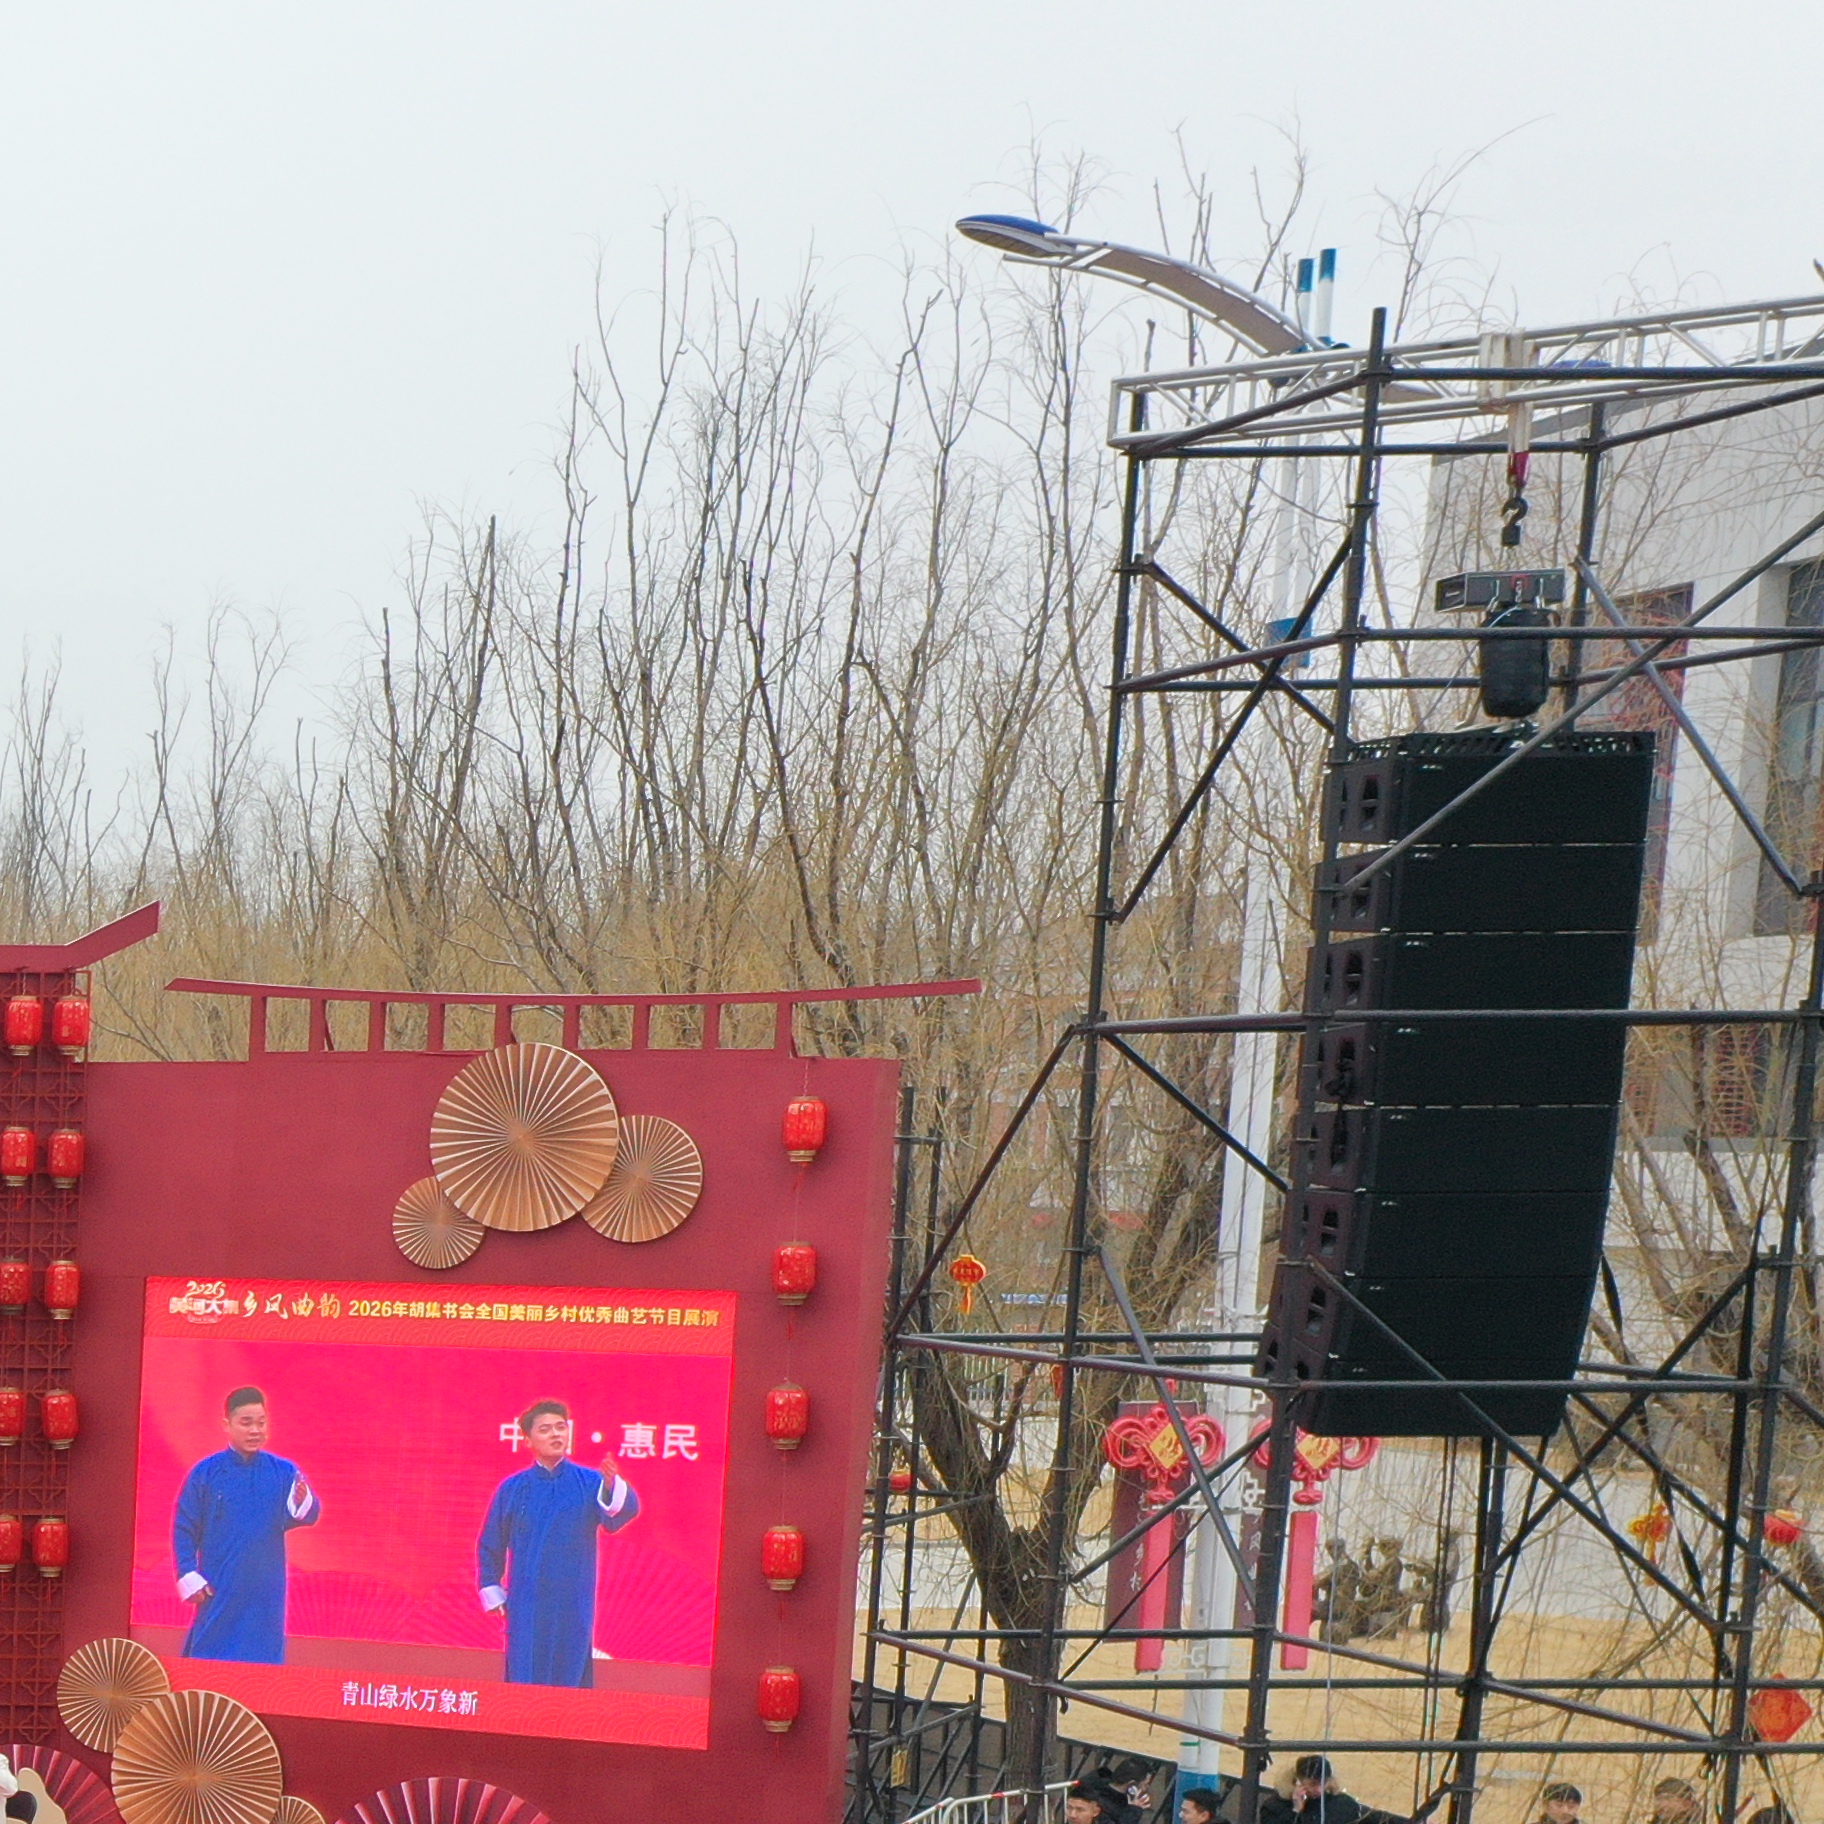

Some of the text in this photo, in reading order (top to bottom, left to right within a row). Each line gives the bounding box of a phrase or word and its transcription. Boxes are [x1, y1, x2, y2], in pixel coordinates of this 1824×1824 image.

[242, 1291, 720, 1328] 乡风曲韵 2026年胡集书会全国美丽乡村优秀曲艺节目展演
[499, 1417, 699, 1461] 中·惠民
[341, 1681, 478, 1716] 青山绿水万象新
